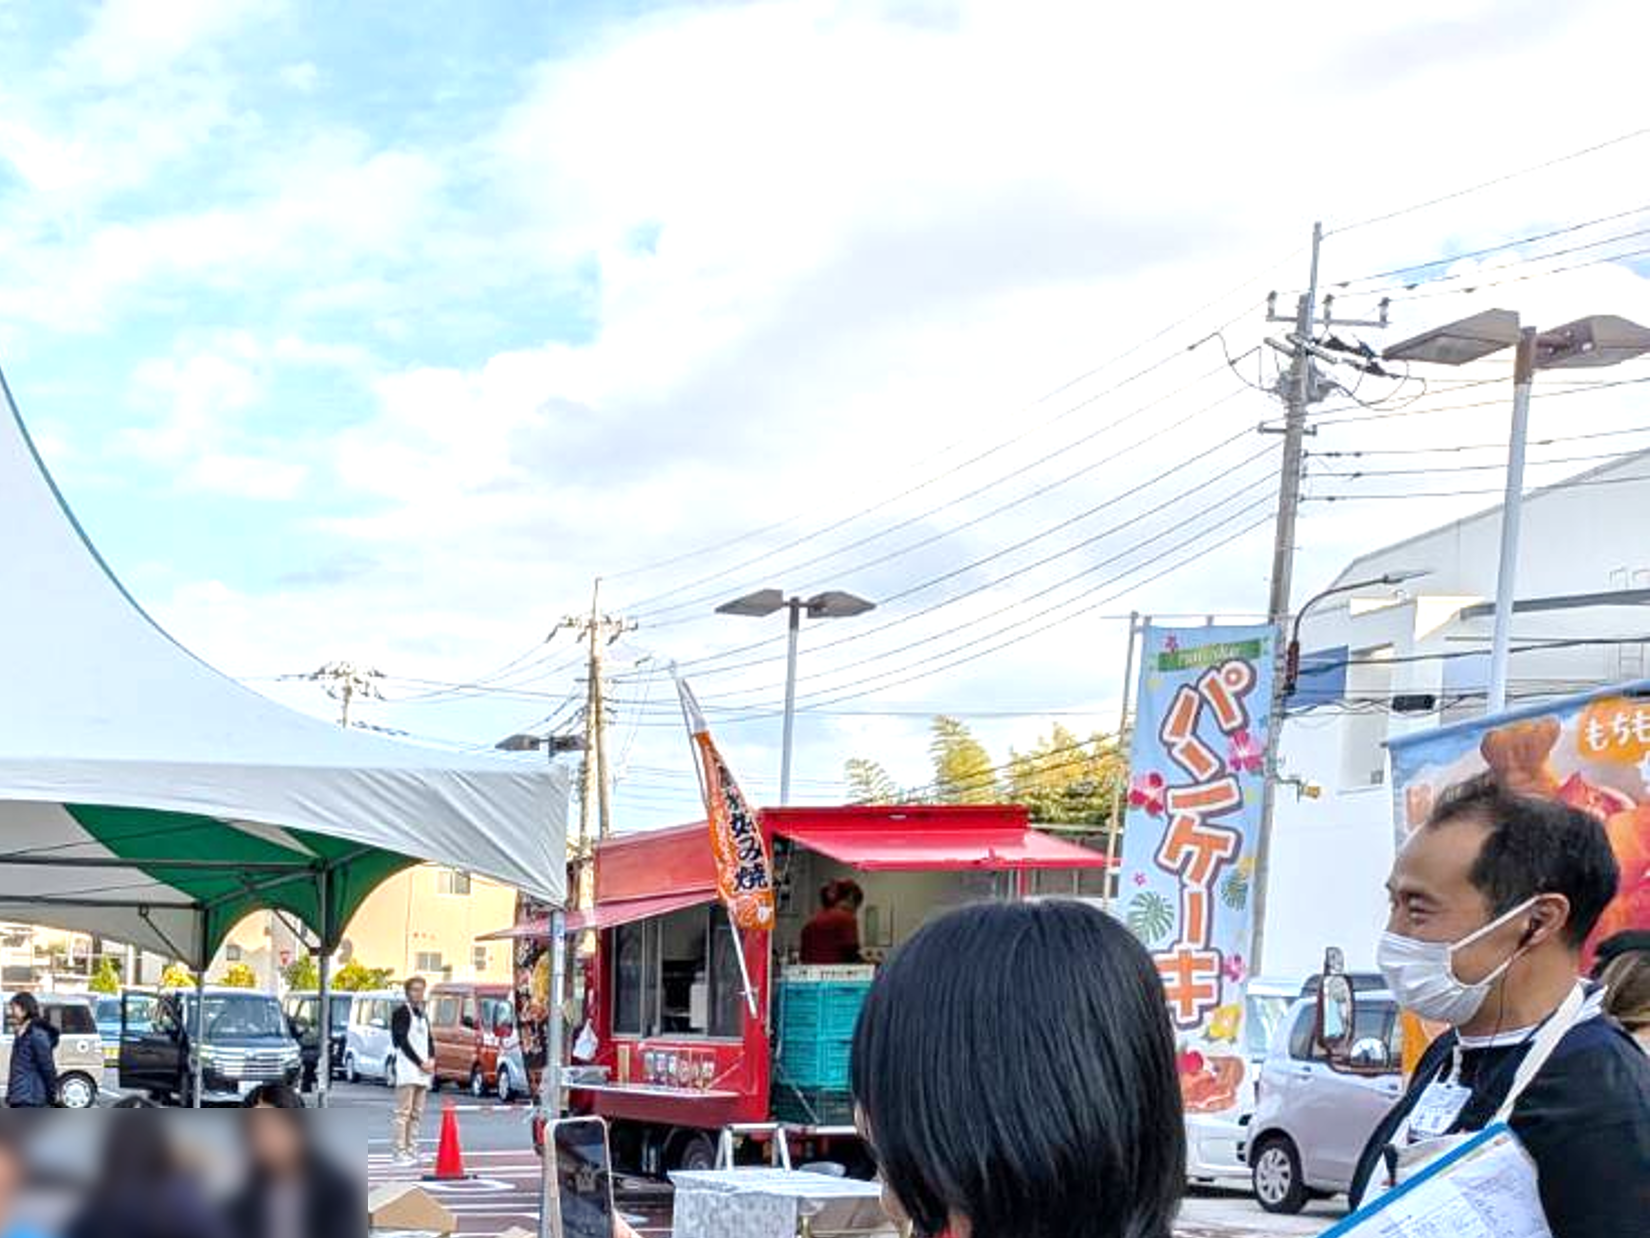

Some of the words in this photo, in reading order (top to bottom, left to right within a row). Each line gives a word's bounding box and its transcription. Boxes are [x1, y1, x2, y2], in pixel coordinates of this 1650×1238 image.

[1155, 659, 1255, 1027] パンケーキ
